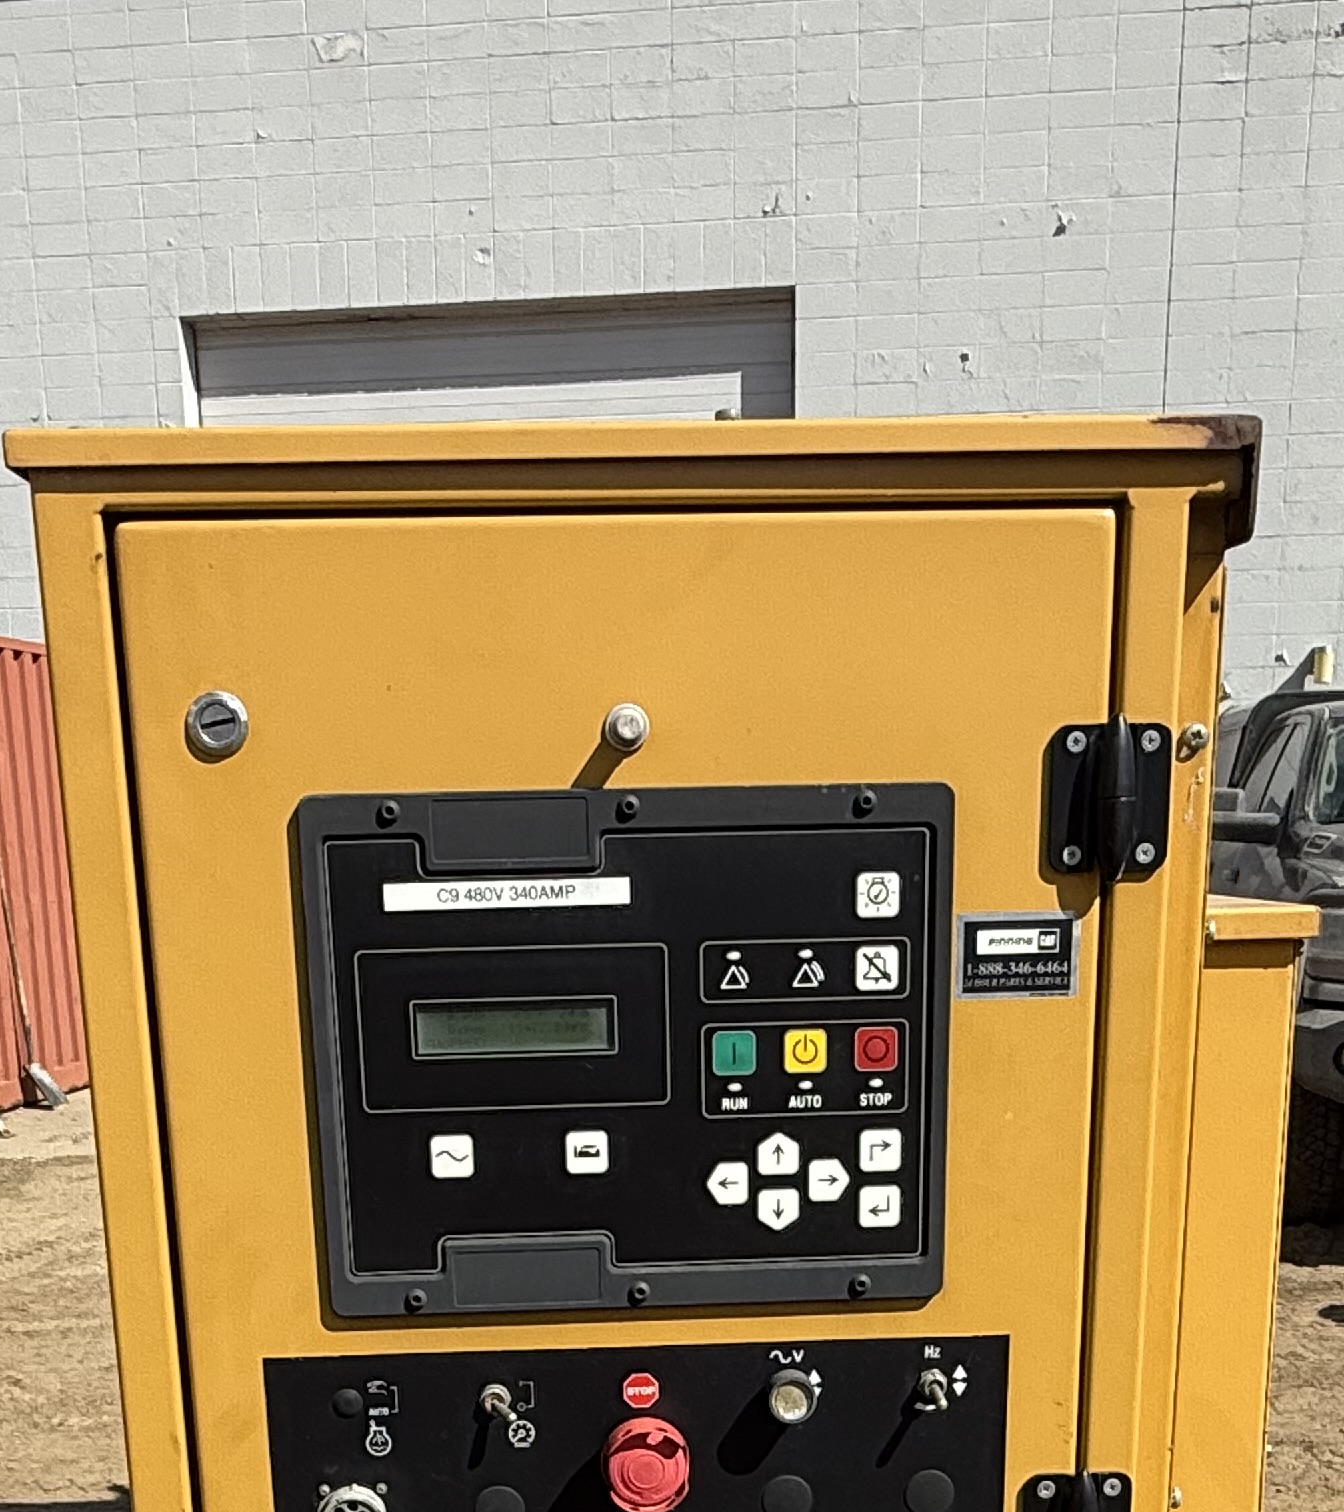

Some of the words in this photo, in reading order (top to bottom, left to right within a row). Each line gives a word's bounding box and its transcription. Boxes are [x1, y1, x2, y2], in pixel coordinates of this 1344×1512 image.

[437, 888, 459, 903] C9
[464, 886, 504, 902] 480V
[509, 884, 576, 901] 340AMP
[966, 961, 1068, 976] 1-888-346-6464
[721, 1096, 748, 1111] RUN
[788, 1095, 822, 1109] AUTO
[859, 1093, 892, 1107] STOP
[924, 1344, 942, 1359] Hz
[627, 1386, 656, 1397] STOP
